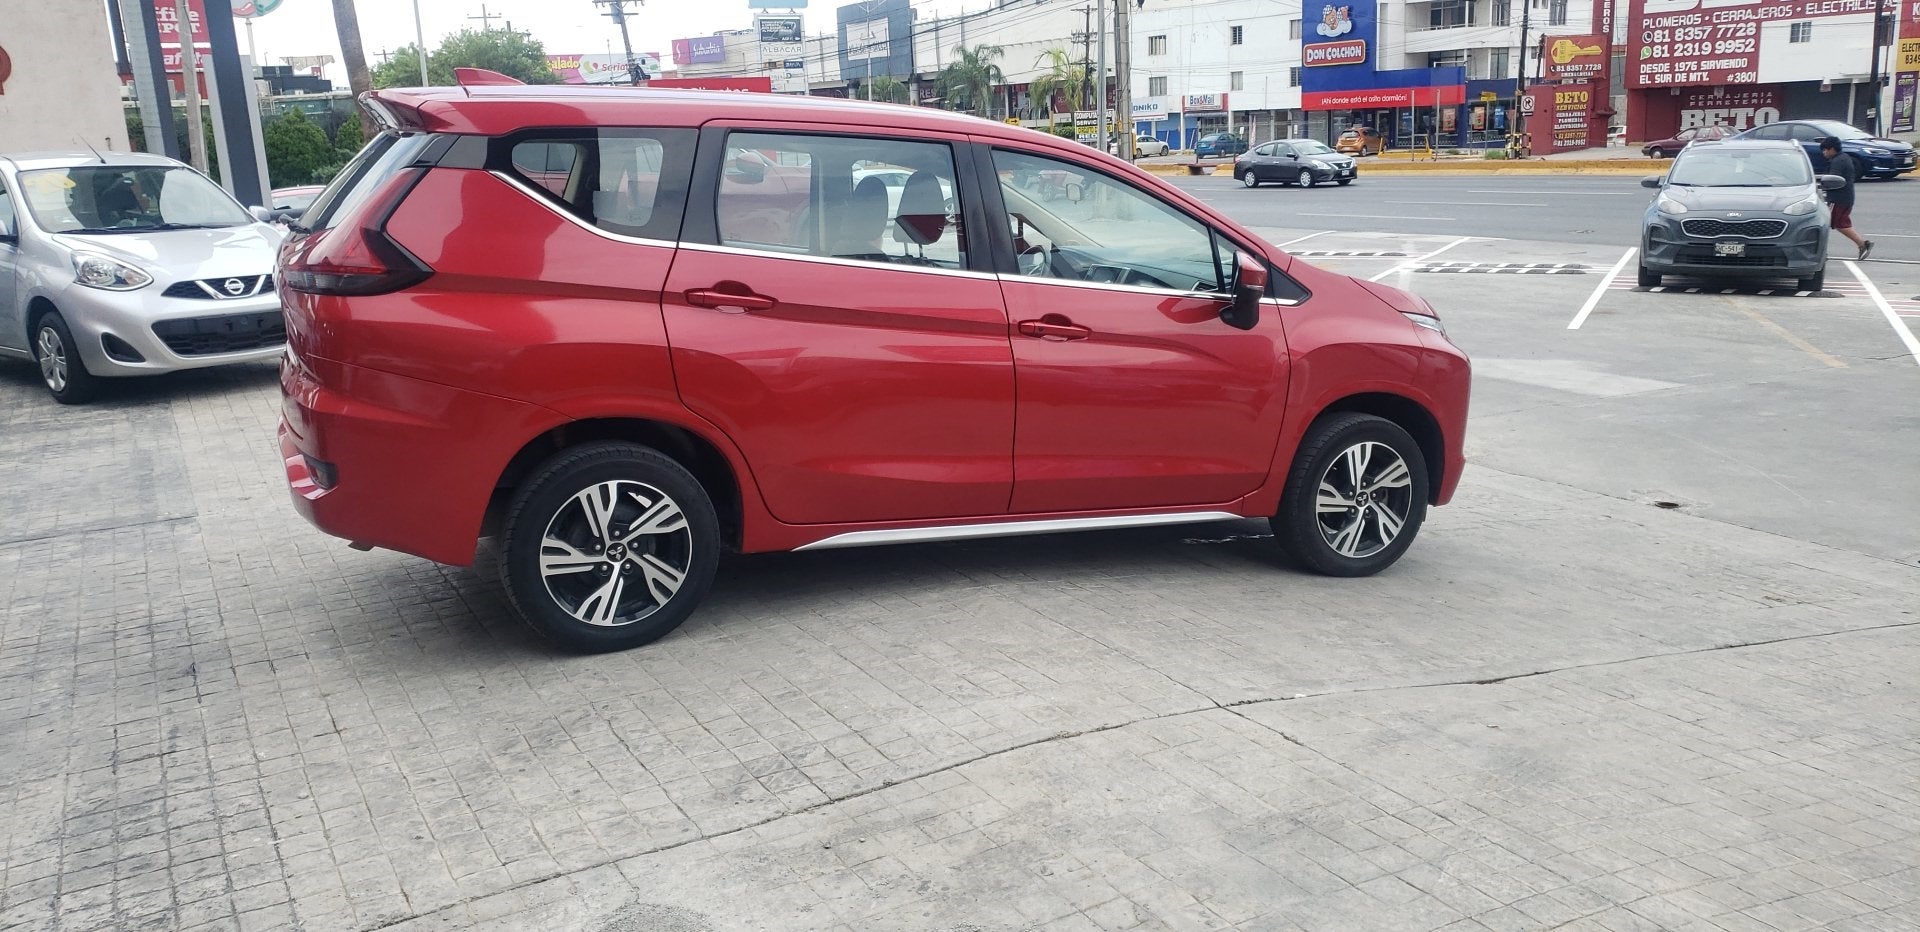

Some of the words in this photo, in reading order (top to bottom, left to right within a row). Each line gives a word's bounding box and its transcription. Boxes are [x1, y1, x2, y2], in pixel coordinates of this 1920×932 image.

[1642, 14, 1702, 29] PLOMEROS
[1713, 6, 1792, 23] CERRAJEROS
[1653, 30, 1671, 43] 81
[1675, 26, 1713, 41] 8357
[1716, 22, 1757, 38] 7728
[1307, 49, 1325, 62] DON
[1326, 45, 1362, 61] COLCHON
[1652, 45, 1670, 58] 81
[1674, 41, 1712, 57] 2319
[1715, 38, 1756, 54] 9952
[1567, 64, 1583, 72] 8357
[1584, 63, 1602, 71] 7728
[1640, 63, 1671, 74] DESDE
[1674, 61, 1698, 72] 1976
[1700, 58, 1748, 71] SIRVIENDO
[1639, 75, 1652, 85] EL
[1654, 73, 1673, 84] SUR
[1675, 72, 1688, 83] DE
[1726, 72, 1756, 83] #3801
[1368, 94, 1381, 102] osito
[1555, 91, 1589, 104] BETO
[1690, 98, 1773, 107] FERRETERIA
[1680, 107, 1780, 131] BETO
